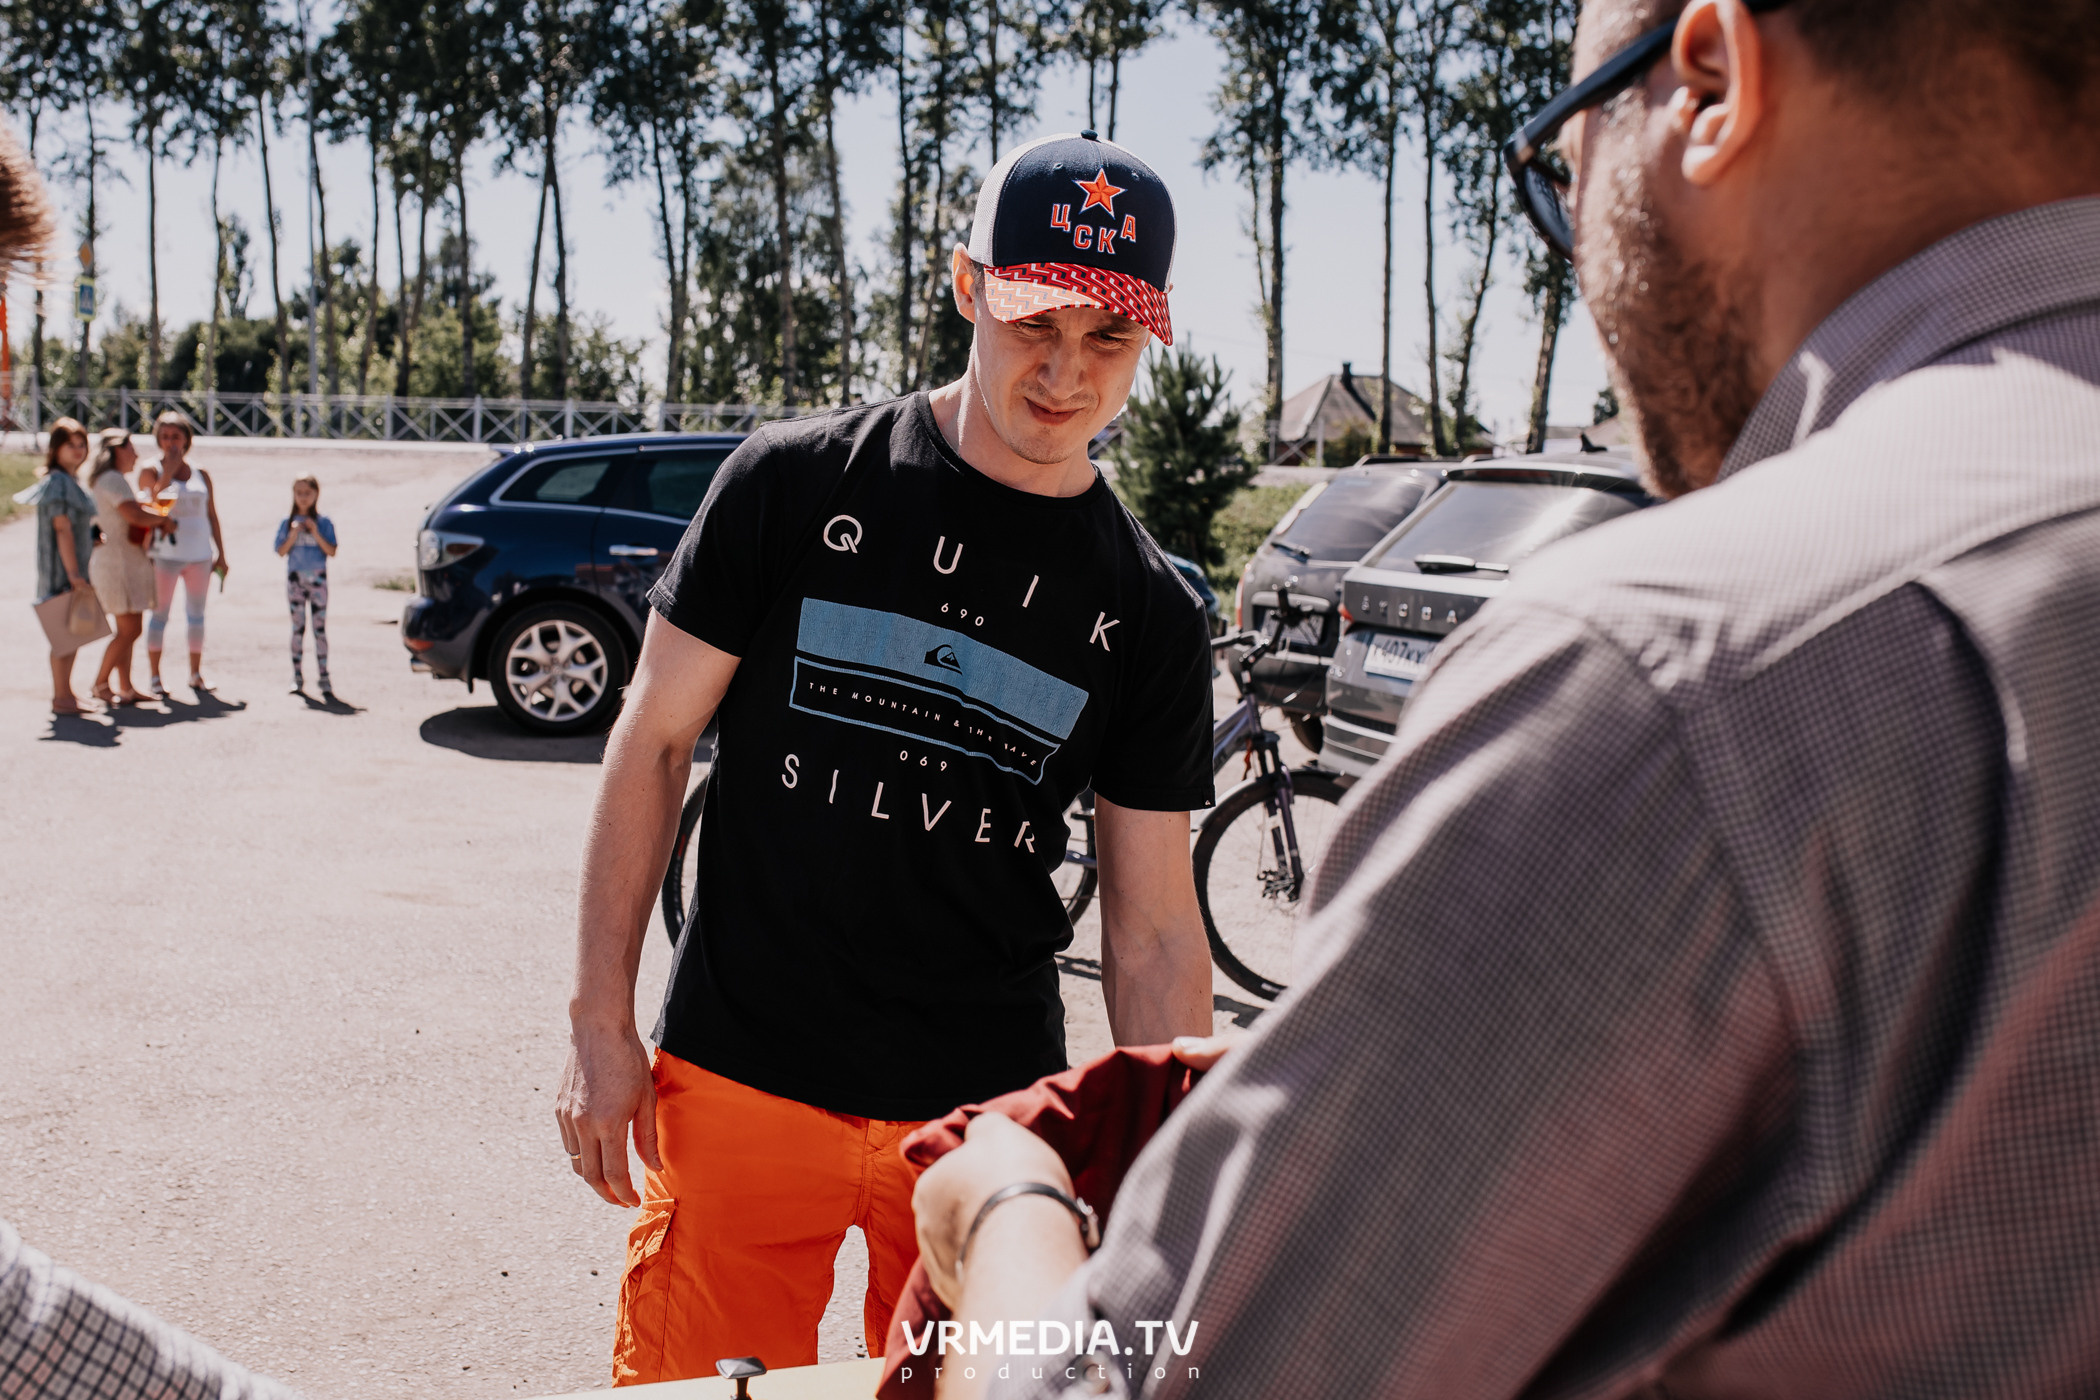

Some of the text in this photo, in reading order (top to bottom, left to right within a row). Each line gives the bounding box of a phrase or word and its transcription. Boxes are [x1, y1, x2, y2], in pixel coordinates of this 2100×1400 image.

[1050, 203, 1137, 255] ЦСКА
[823, 514, 1121, 652] QUIK
[940, 602, 984, 627] 690
[809, 682, 839, 696] THE
[851, 691, 942, 722] MOUNTAIN
[953, 719, 961, 728] &
[899, 750, 949, 772] 069
[781, 753, 1036, 853] SILVER
